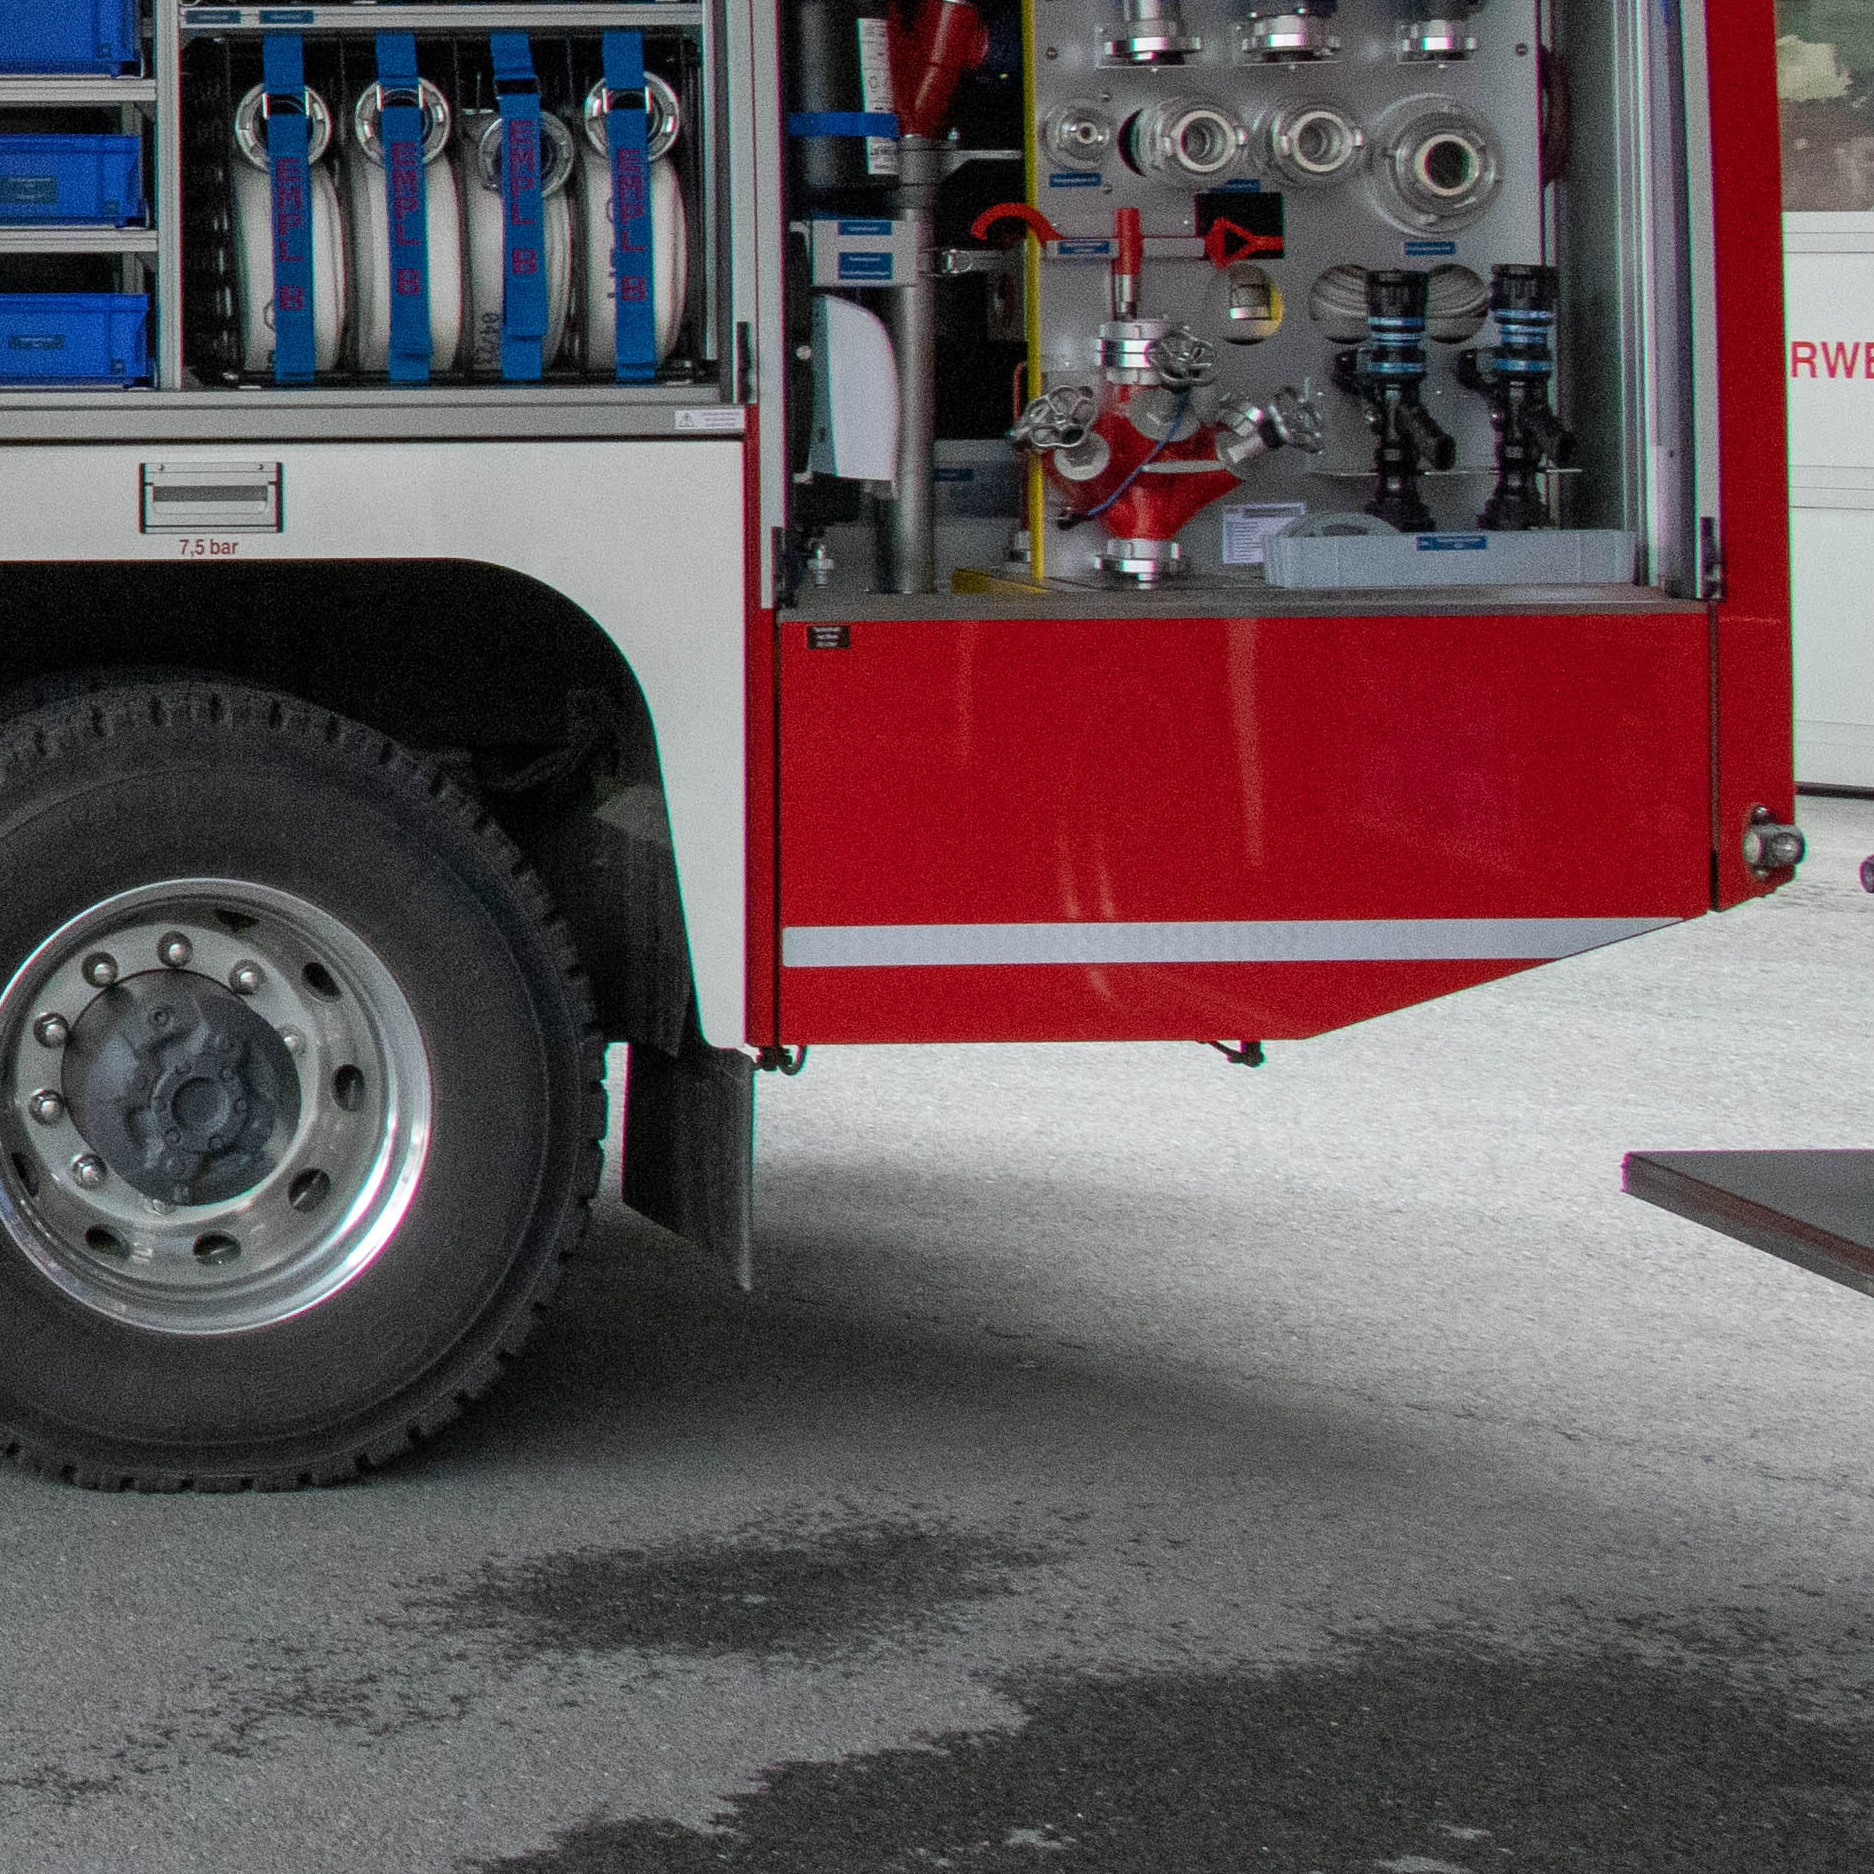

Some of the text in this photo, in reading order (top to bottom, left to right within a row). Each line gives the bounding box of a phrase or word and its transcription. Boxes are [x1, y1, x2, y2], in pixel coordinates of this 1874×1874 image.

[276, 157, 305, 311] EMPL B
[391, 141, 422, 296] EMPL B
[508, 119, 537, 275] EMPL B
[616, 148, 647, 302] EMPL B
[179, 538, 239, 557] 7,5 bar
